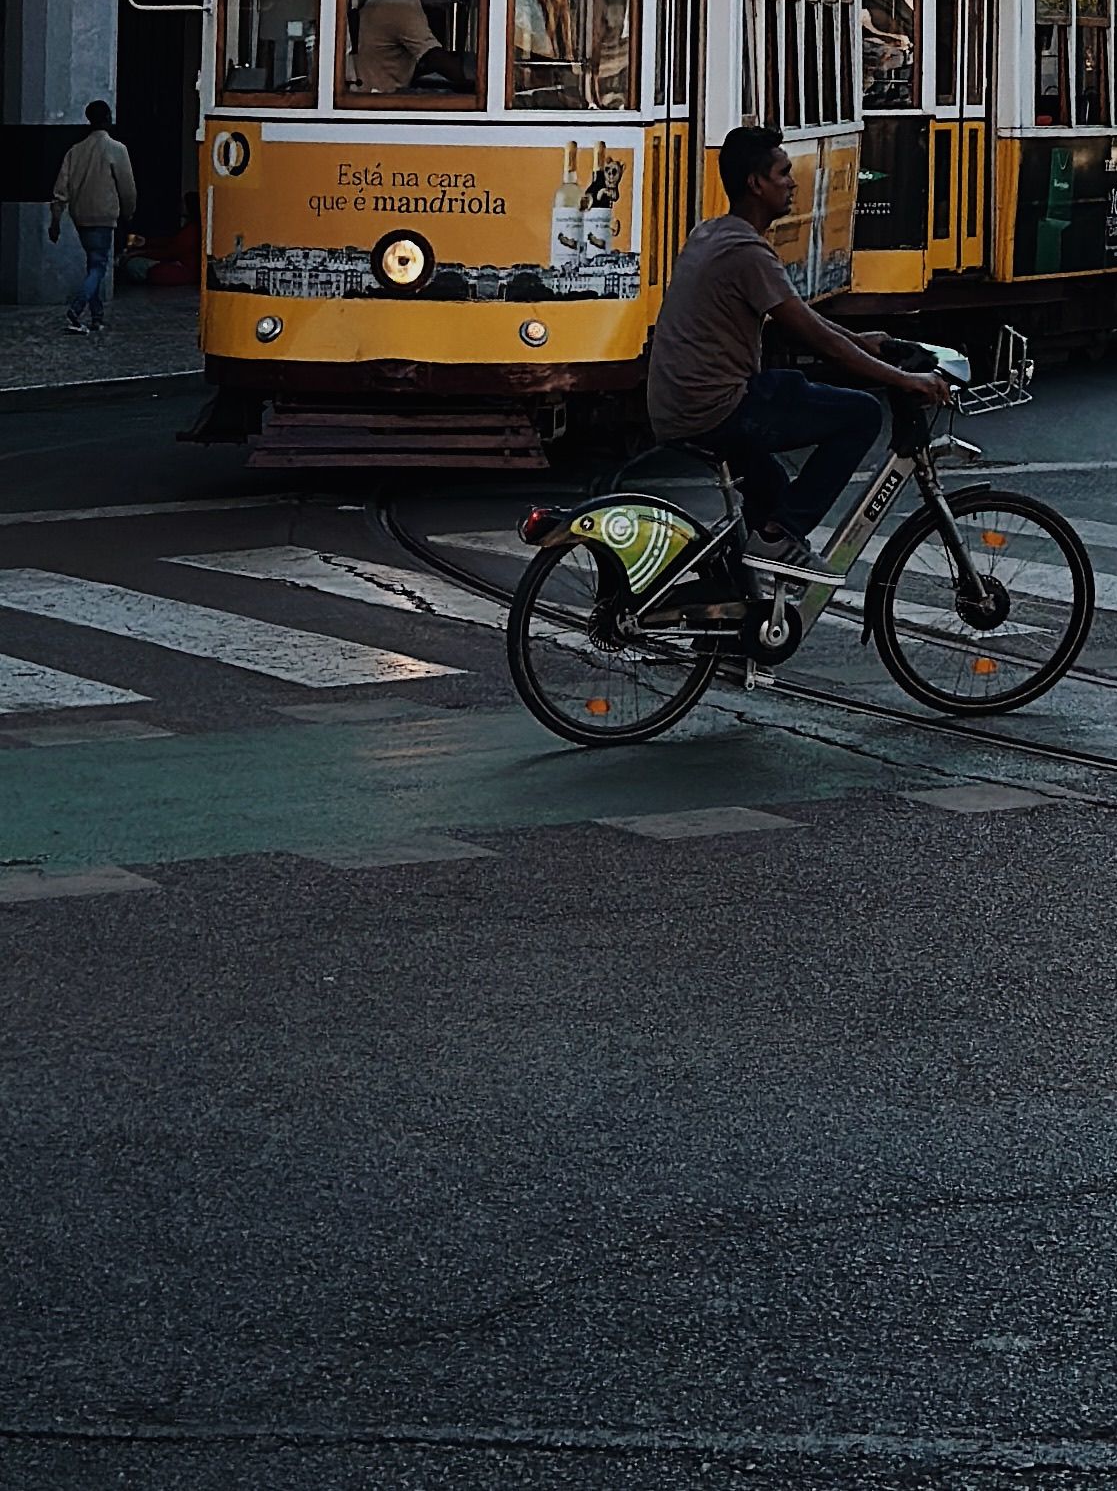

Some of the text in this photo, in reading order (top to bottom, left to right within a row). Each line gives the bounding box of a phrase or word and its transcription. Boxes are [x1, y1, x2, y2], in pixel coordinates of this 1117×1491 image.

[337, 162, 476, 188] Está na cara
[308, 187, 507, 217] que é mandriola
[872, 476, 897, 512] E 2114
